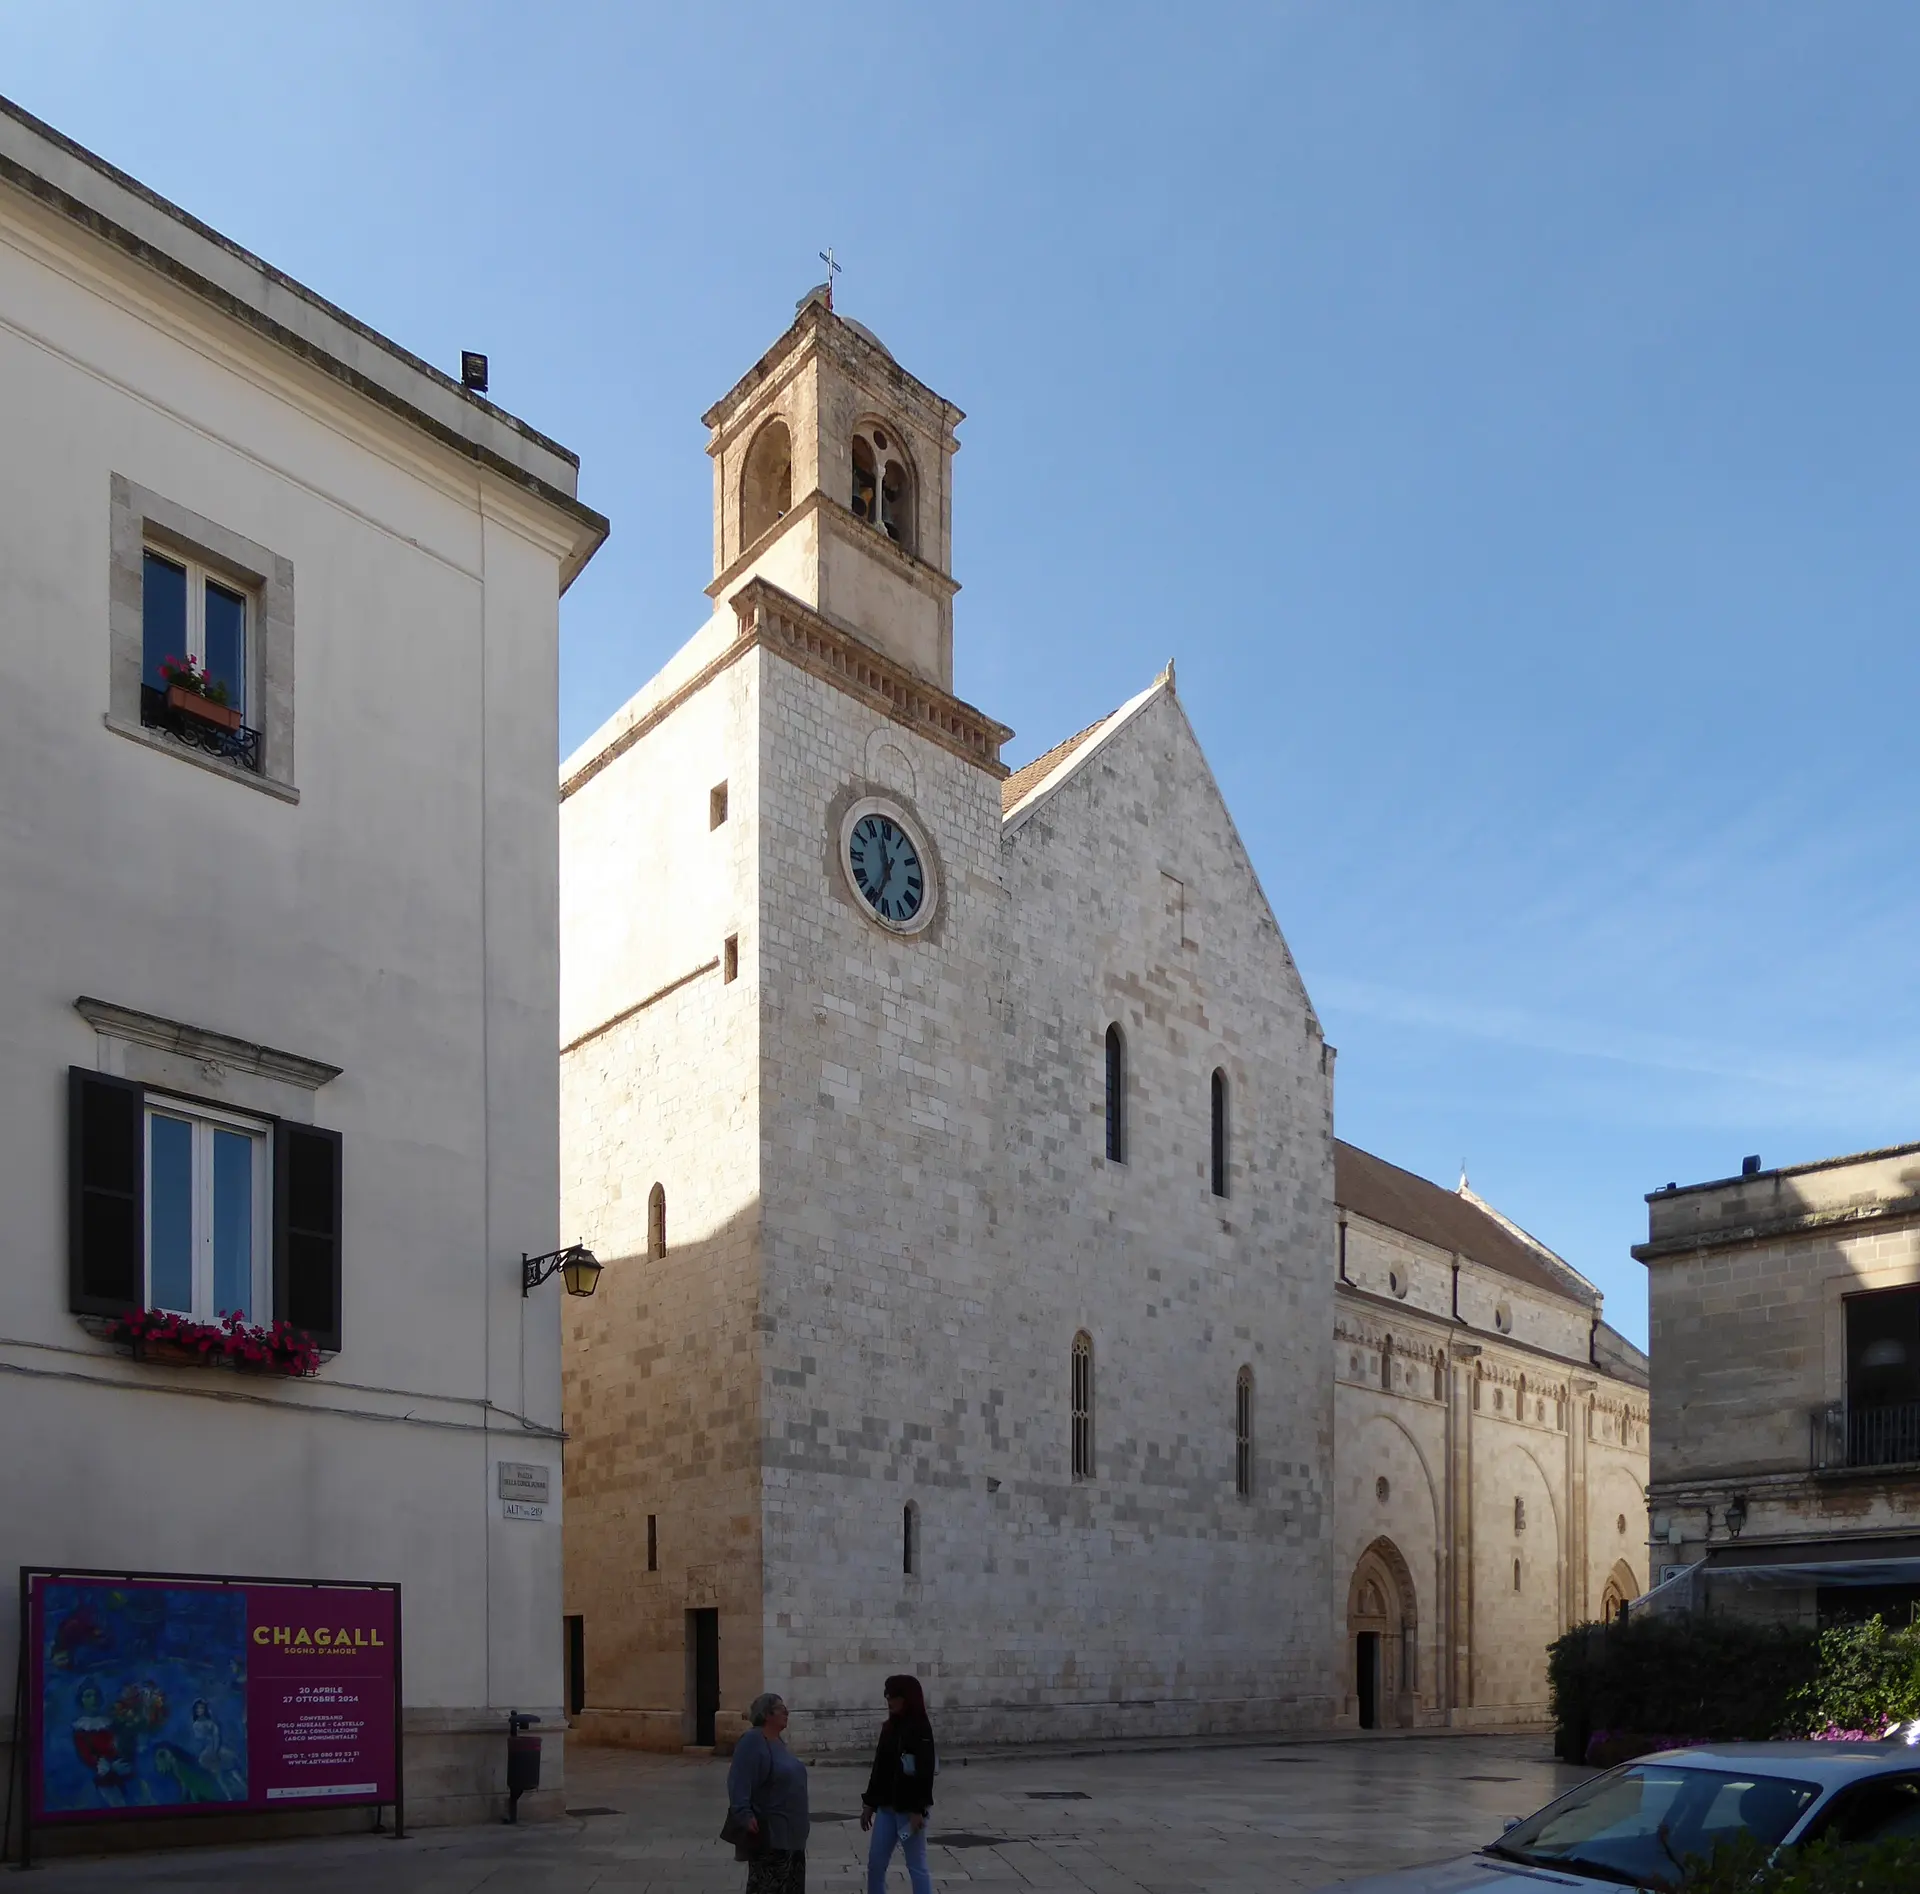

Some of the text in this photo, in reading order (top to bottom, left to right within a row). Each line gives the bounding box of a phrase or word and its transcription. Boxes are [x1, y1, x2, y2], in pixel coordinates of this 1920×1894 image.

[530, 1507, 543, 1517] 219
[253, 1626, 384, 1646] CHAGALL
[284, 1647, 357, 1655] SOGNO D'AMORE
[313, 1686, 343, 1694] APRILE
